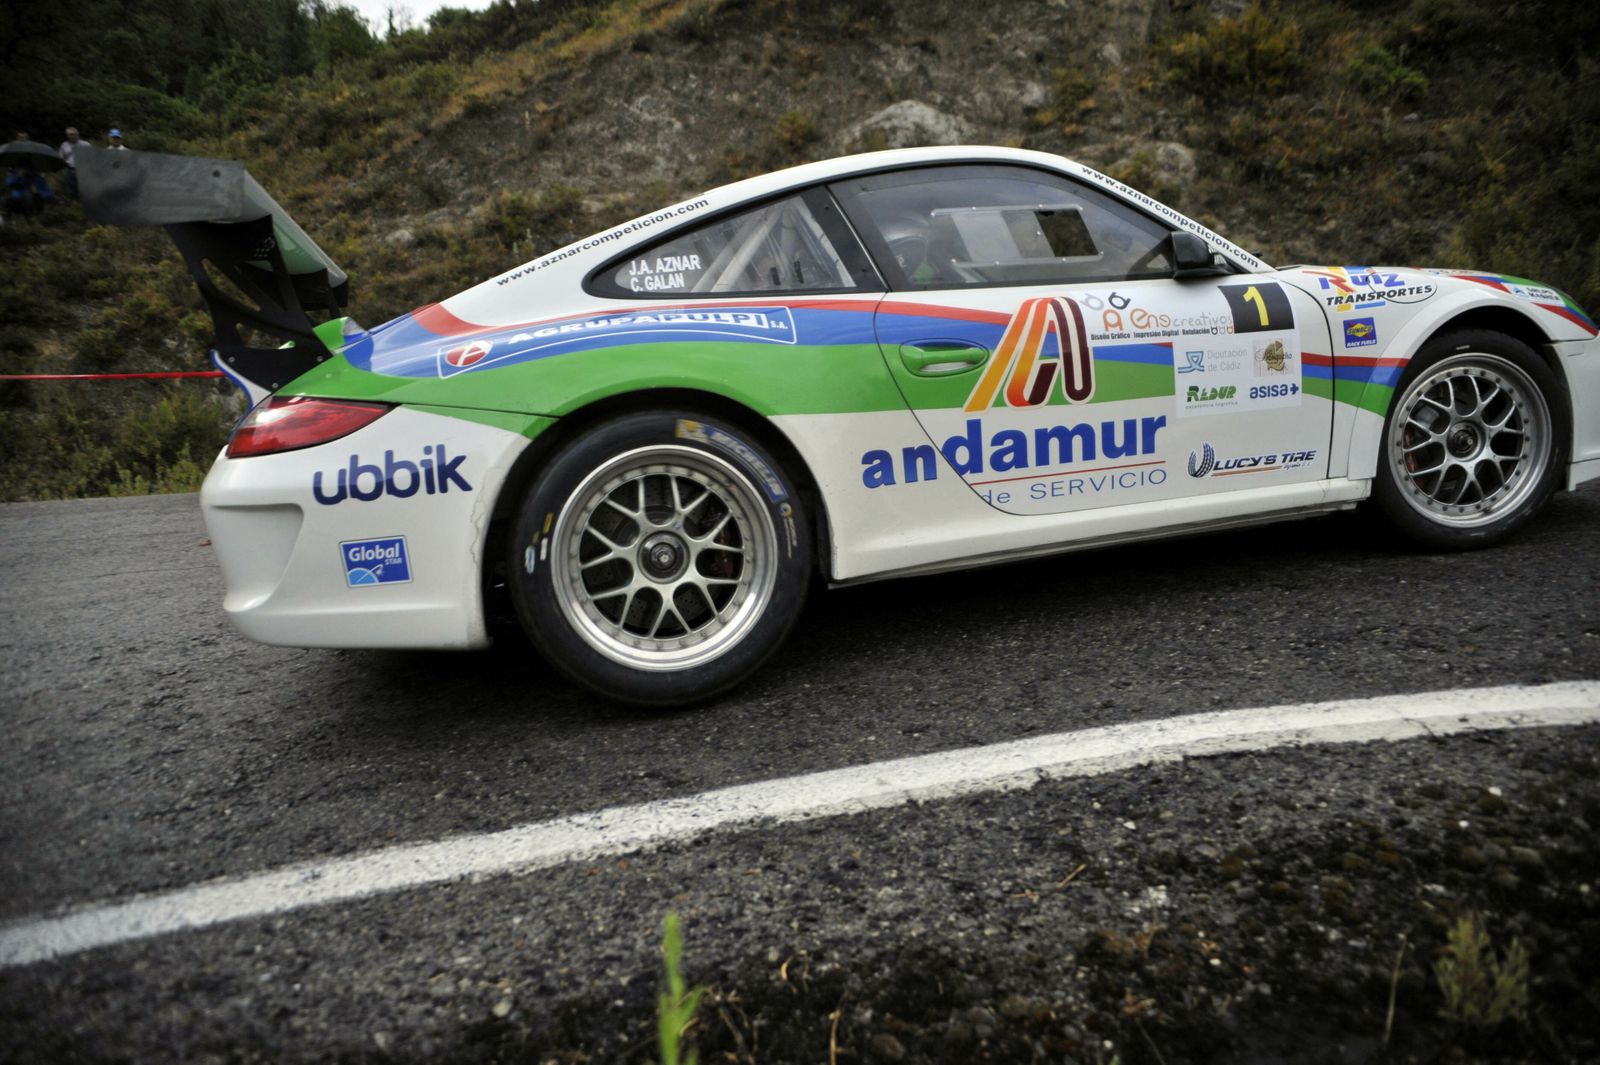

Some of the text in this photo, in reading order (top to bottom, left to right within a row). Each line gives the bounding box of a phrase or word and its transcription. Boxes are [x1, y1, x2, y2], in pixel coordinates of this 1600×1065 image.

[1083, 167, 1260, 268] www.aznarcompeticion.com
[497, 199, 708, 287] www.aznarcompeticion.com
[629, 255, 701, 275] J.A. AZNAR
[630, 273, 685, 292] C. GALAN
[1326, 285, 1432, 306] TRANSPORTES
[1243, 286, 1269, 327] 1
[1163, 329, 1179, 337] Digital
[1346, 325, 1373, 336] SUNOCO
[861, 415, 1167, 488] andamur
[1213, 455, 1278, 470] LUCY'S
[1281, 450, 1317, 463] TIRE
[313, 444, 473, 505] ubbik
[1030, 468, 1167, 500] SERVICIO
[348, 543, 399, 561] Global
